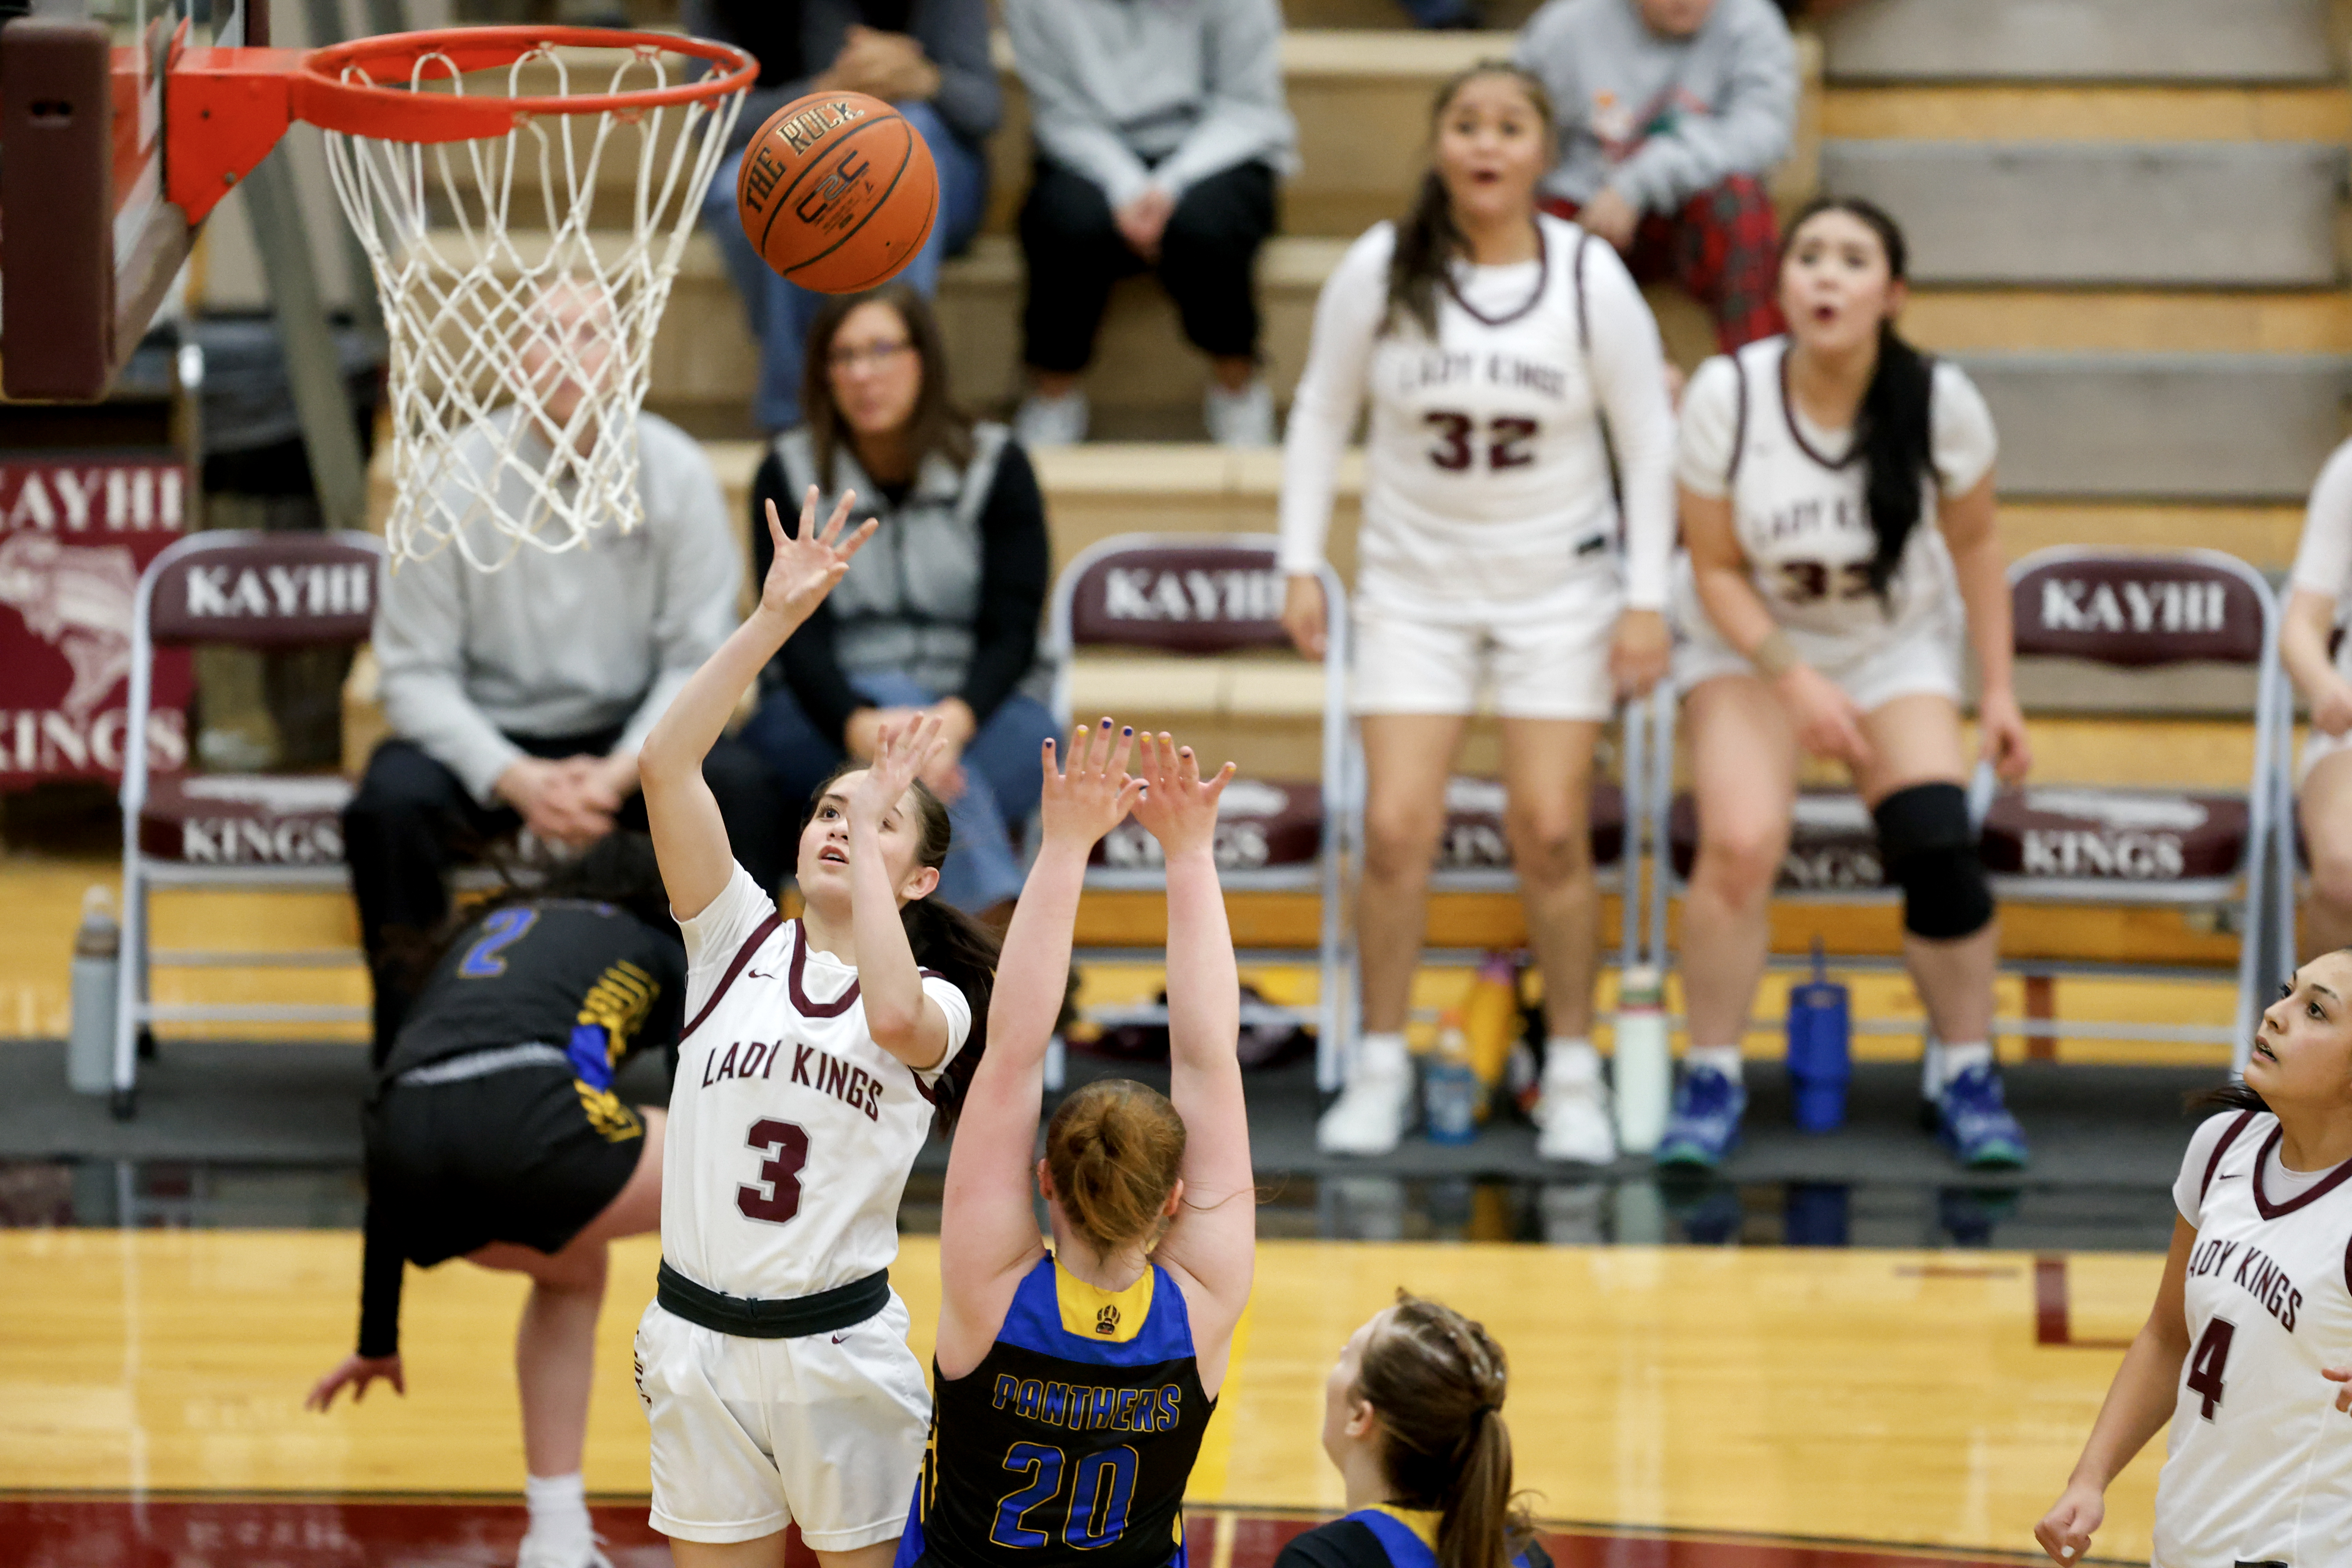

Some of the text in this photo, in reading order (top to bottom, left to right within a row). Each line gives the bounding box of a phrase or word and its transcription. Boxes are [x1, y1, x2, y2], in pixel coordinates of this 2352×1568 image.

[746, 146, 787, 212] THE
[775, 102, 858, 157] ROCK
[1423, 411, 1538, 471] 32
[0, 466, 183, 531] AYHI
[187, 564, 369, 618] KAYHI
[2042, 578, 2225, 633] KAYHI
[183, 816, 347, 862] KINGS
[2023, 828, 2185, 877] KINGS
[457, 906, 539, 979] 2
[701, 1040, 883, 1122] LADY KINGS
[734, 1115, 812, 1227] 3
[2233, 1246, 2303, 1334] KINGS
[992, 1373, 1181, 1432] PANTHERS
[2186, 1313, 2238, 1425] 4
[989, 1441, 1139, 1551] 20
